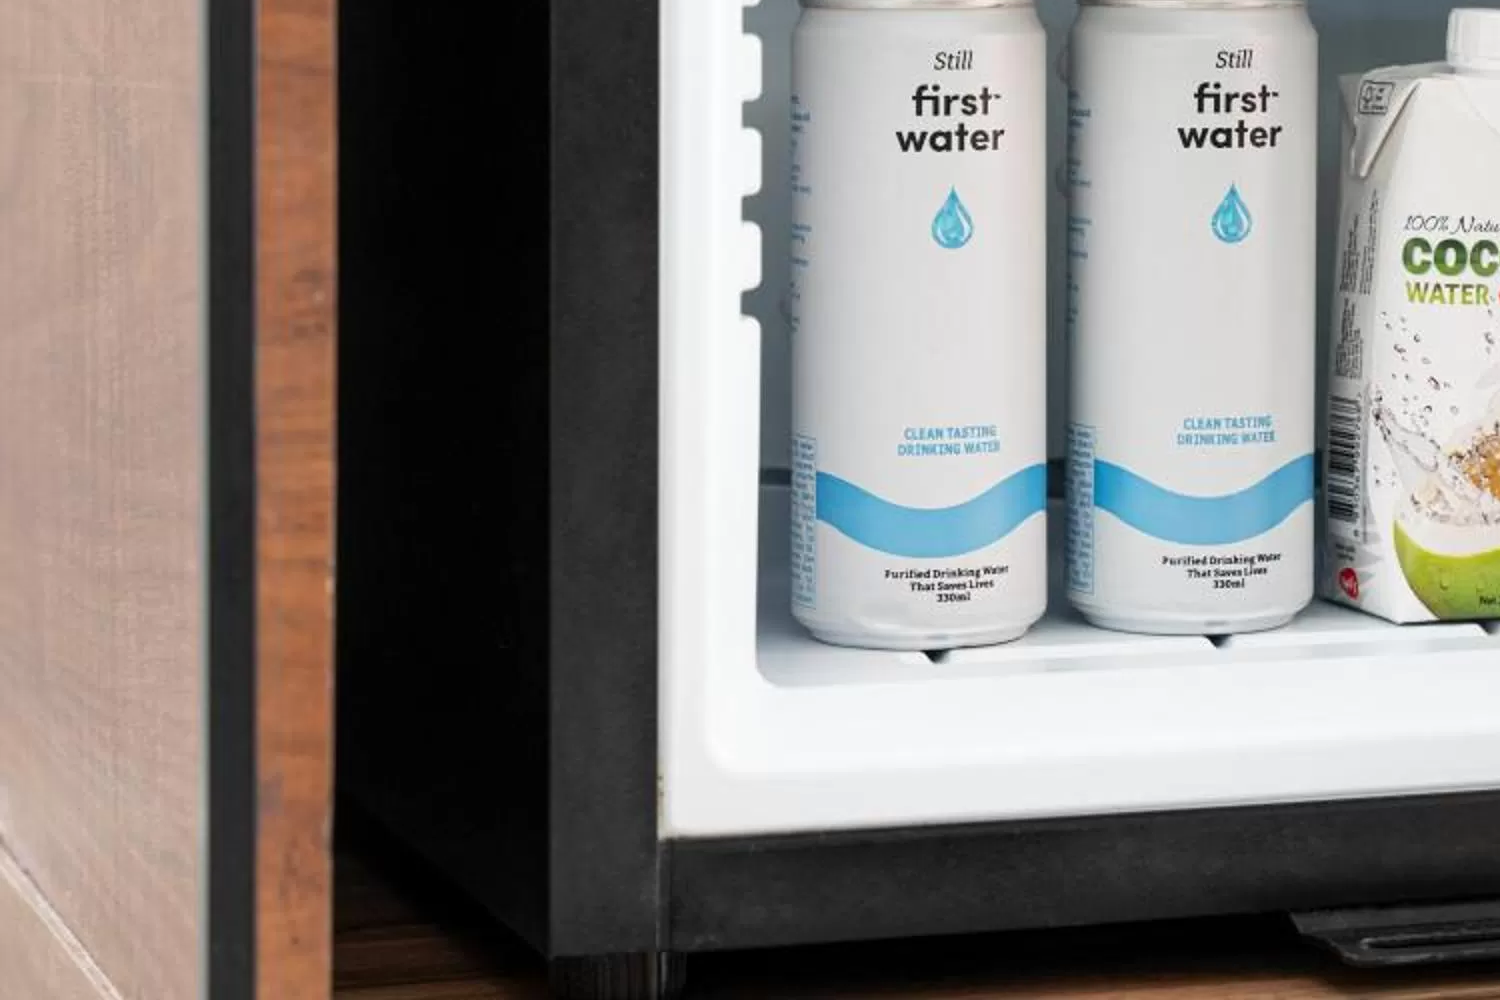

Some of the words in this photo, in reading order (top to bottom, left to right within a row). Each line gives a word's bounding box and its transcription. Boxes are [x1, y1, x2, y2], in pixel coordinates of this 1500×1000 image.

[932, 50, 973, 71] Still
[1215, 49, 1253, 69] Still
[911, 84, 994, 117] first
[1193, 82, 1273, 113] first
[896, 123, 1005, 152] water
[1177, 120, 1283, 149] water
[1404, 215, 1449, 232] 100%
[1406, 281, 1490, 306] WATER
[1183, 416, 1221, 430] CLEAN
[1225, 415, 1273, 429] TASTING
[904, 426, 943, 441] CLEAN
[947, 424, 997, 439] TASTING
[1177, 433, 1239, 446] DRINKING
[1242, 430, 1275, 444] WATER
[897, 443, 960, 457] DRINKING
[963, 440, 1000, 454] WATER
[1162, 554, 1207, 566] Purified
[1209, 554, 1255, 567] Drinking
[1257, 552, 1282, 563] Water
[884, 569, 930, 579] Purified
[933, 567, 980, 580] Drinking
[983, 565, 1009, 575] Water
[1187, 568, 1211, 578] That
[1213, 568, 1241, 578] Saves
[1243, 566, 1268, 577] Lives
[910, 581, 935, 592] That
[937, 581, 967, 591] Saves
[969, 579, 994, 590] Lives
